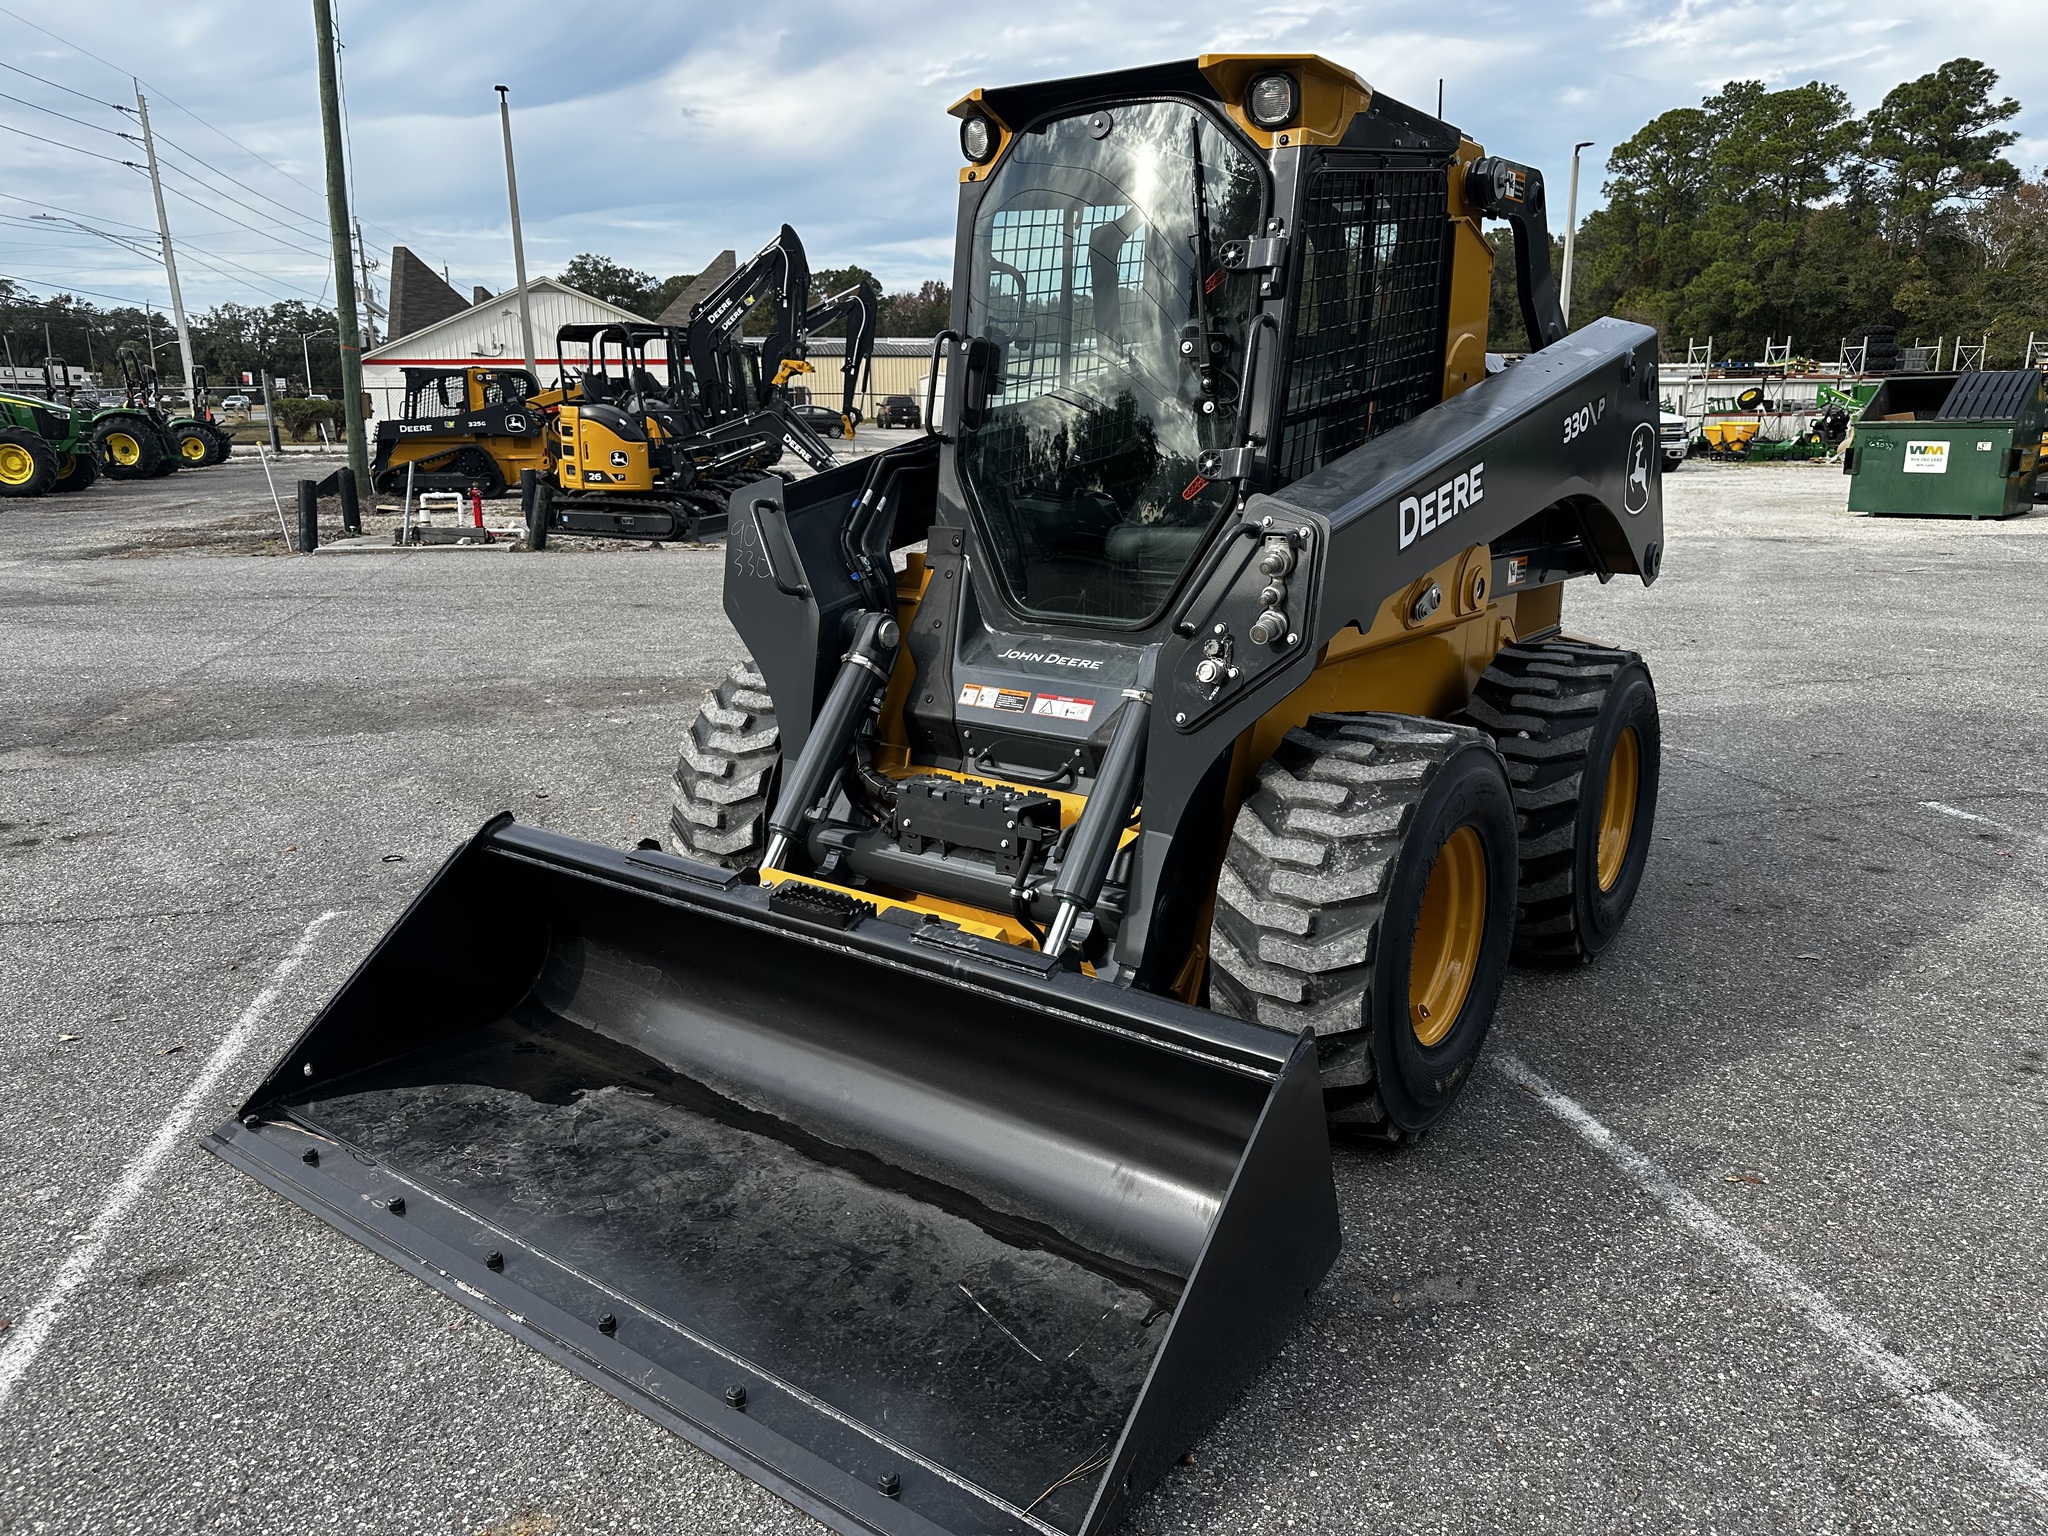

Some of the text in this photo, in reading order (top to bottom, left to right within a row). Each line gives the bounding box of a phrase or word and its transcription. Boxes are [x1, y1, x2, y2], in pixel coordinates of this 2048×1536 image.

[707, 297, 733, 324] DEERE
[721, 306, 744, 331] DEERE
[399, 424, 433, 433] DEERE
[782, 432, 812, 462] DEERE
[1909, 445, 1944, 455] WM
[588, 472, 602, 481] 26
[1400, 461, 1484, 551] DEERE
[733, 548, 771, 578] 330
[997, 649, 1104, 669] JOHN DEERE
